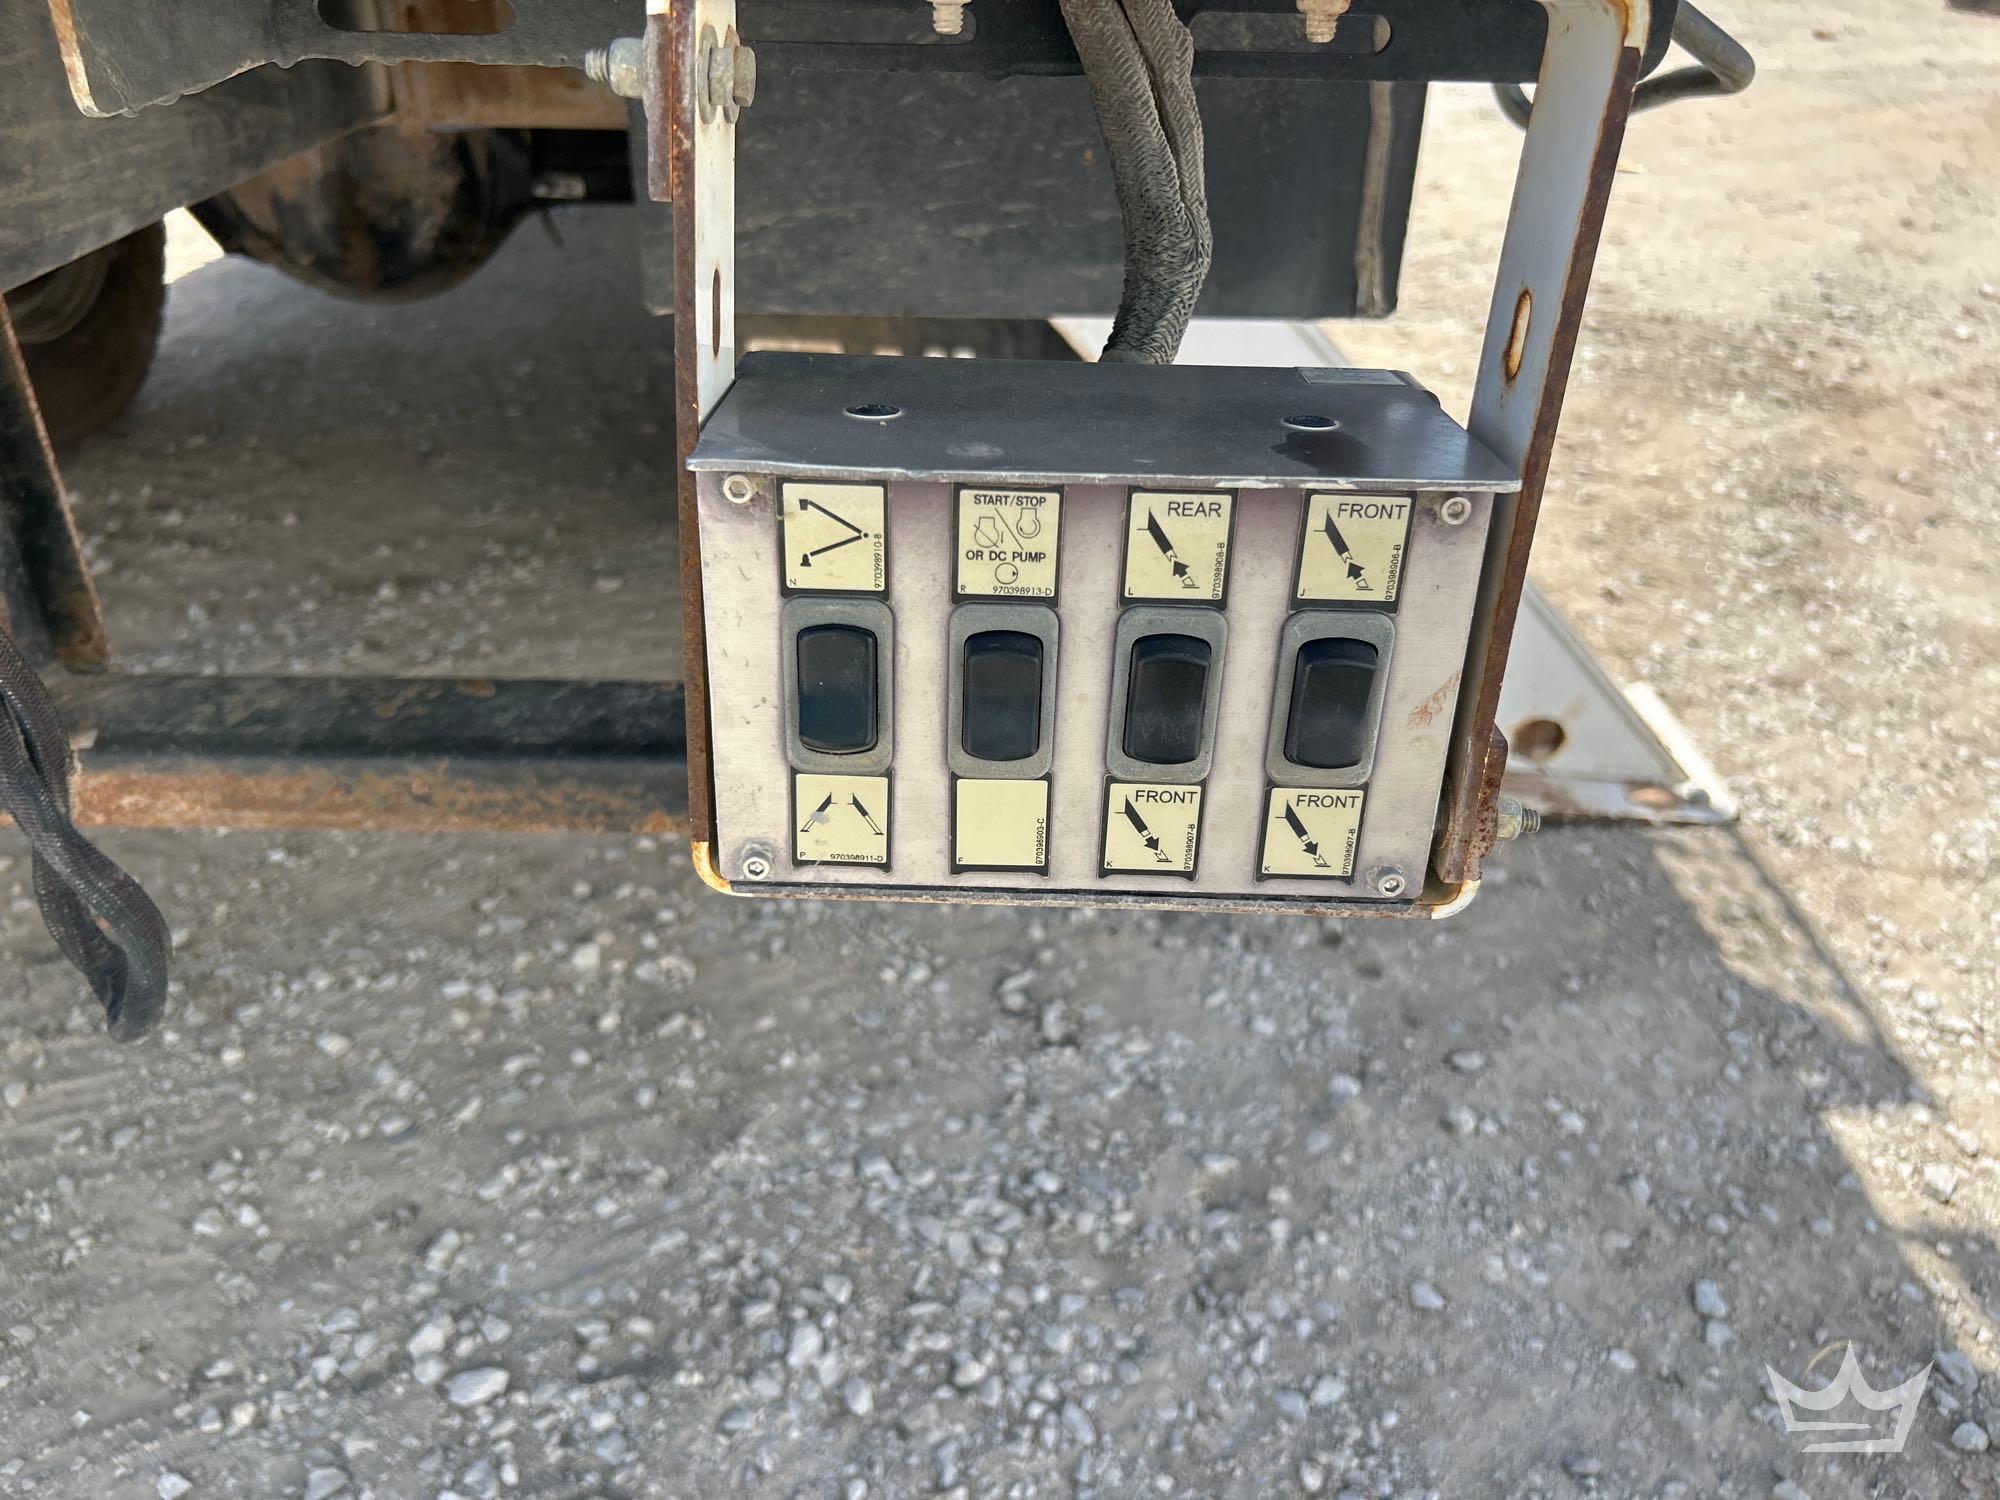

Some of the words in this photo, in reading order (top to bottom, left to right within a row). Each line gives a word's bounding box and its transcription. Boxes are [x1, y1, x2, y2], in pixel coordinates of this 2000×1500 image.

[973, 494, 1046, 507] START/STOP
[1168, 502, 1222, 517] REAR
[1337, 503, 1407, 519] FRONT
[874, 534, 882, 588] 970398910-B
[965, 550, 984, 561] OR
[989, 550, 1007, 561] DC
[1012, 551, 1047, 562] PUMP
[960, 585, 966, 593] R
[992, 586, 1053, 596] 970398913-D
[1128, 587, 1133, 595] L
[1135, 790, 1198, 804] FRONT
[1296, 795, 1359, 808] FRONT
[1035, 818, 1045, 865] 970398903-C
[1184, 823, 1195, 870] 970398907-B
[830, 853, 884, 861] 970398911-D
[1342, 828, 1356, 875] 970398907-B
